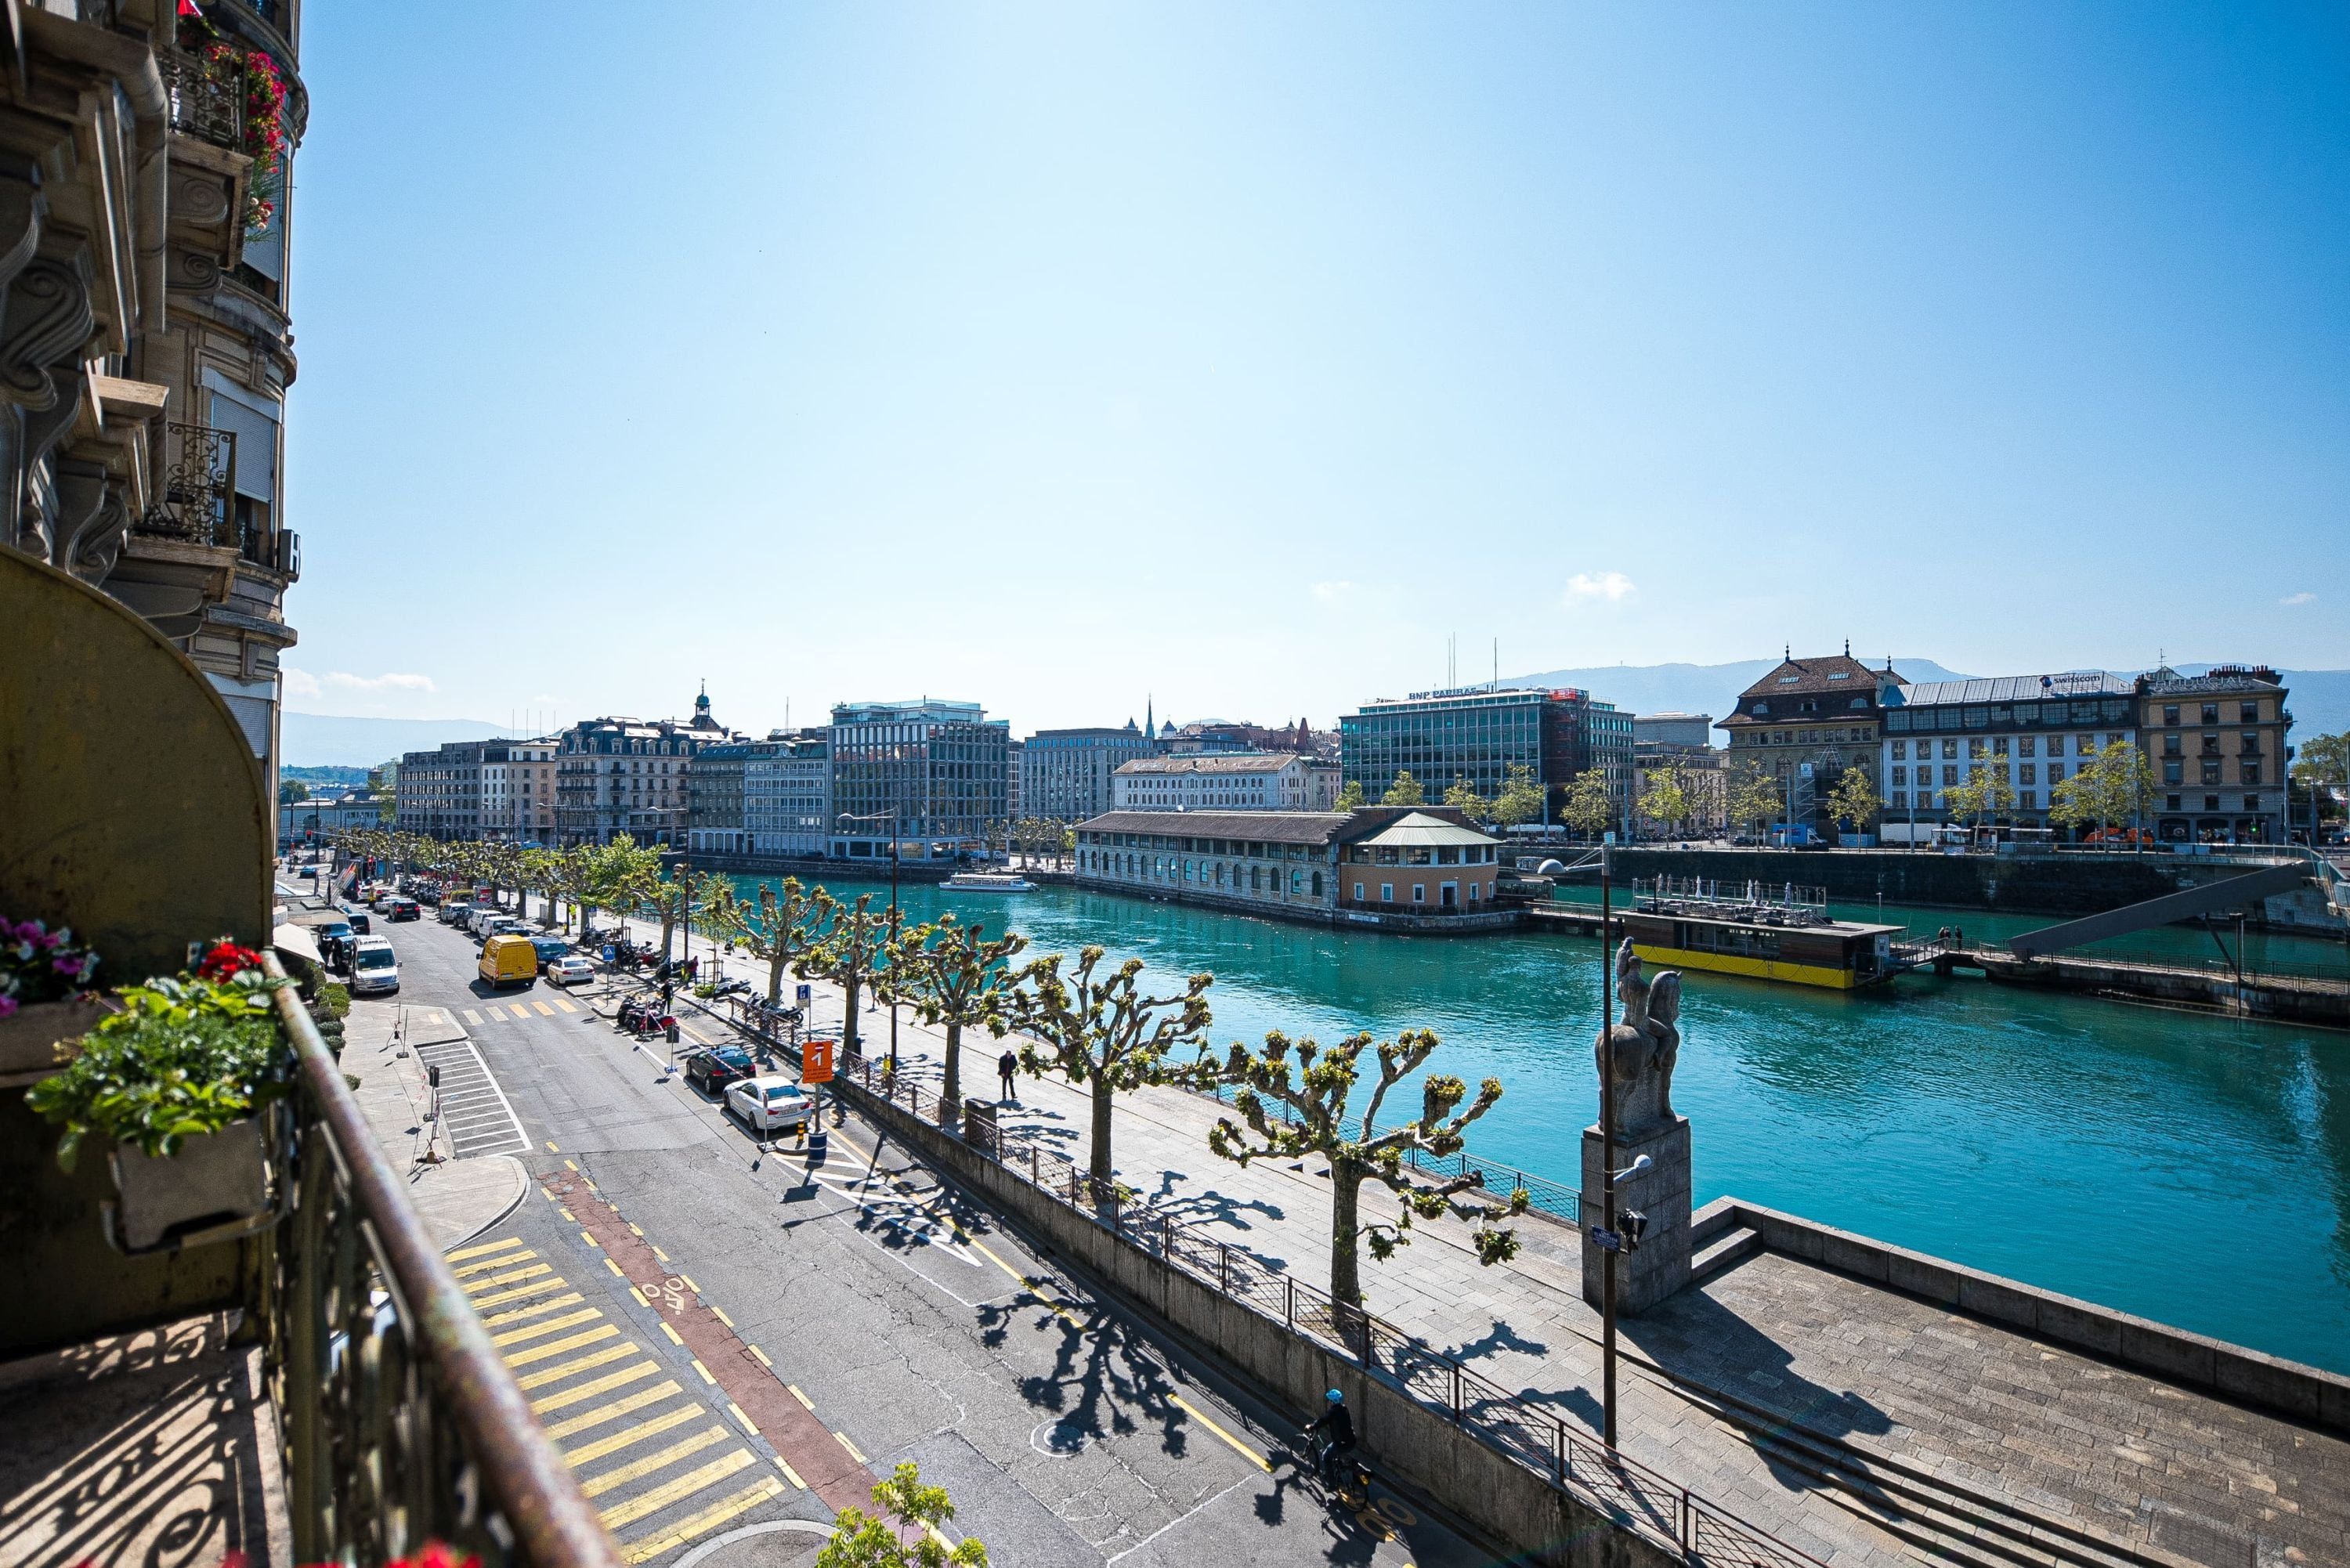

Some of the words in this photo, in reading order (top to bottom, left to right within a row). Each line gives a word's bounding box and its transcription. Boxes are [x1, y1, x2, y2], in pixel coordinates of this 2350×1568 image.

[2054, 675, 2100, 684] swisscom
[1408, 692, 1430, 700] BNP
[1432, 688, 1477, 699] PARIBAS
[811, 1052, 822, 1066] 1
